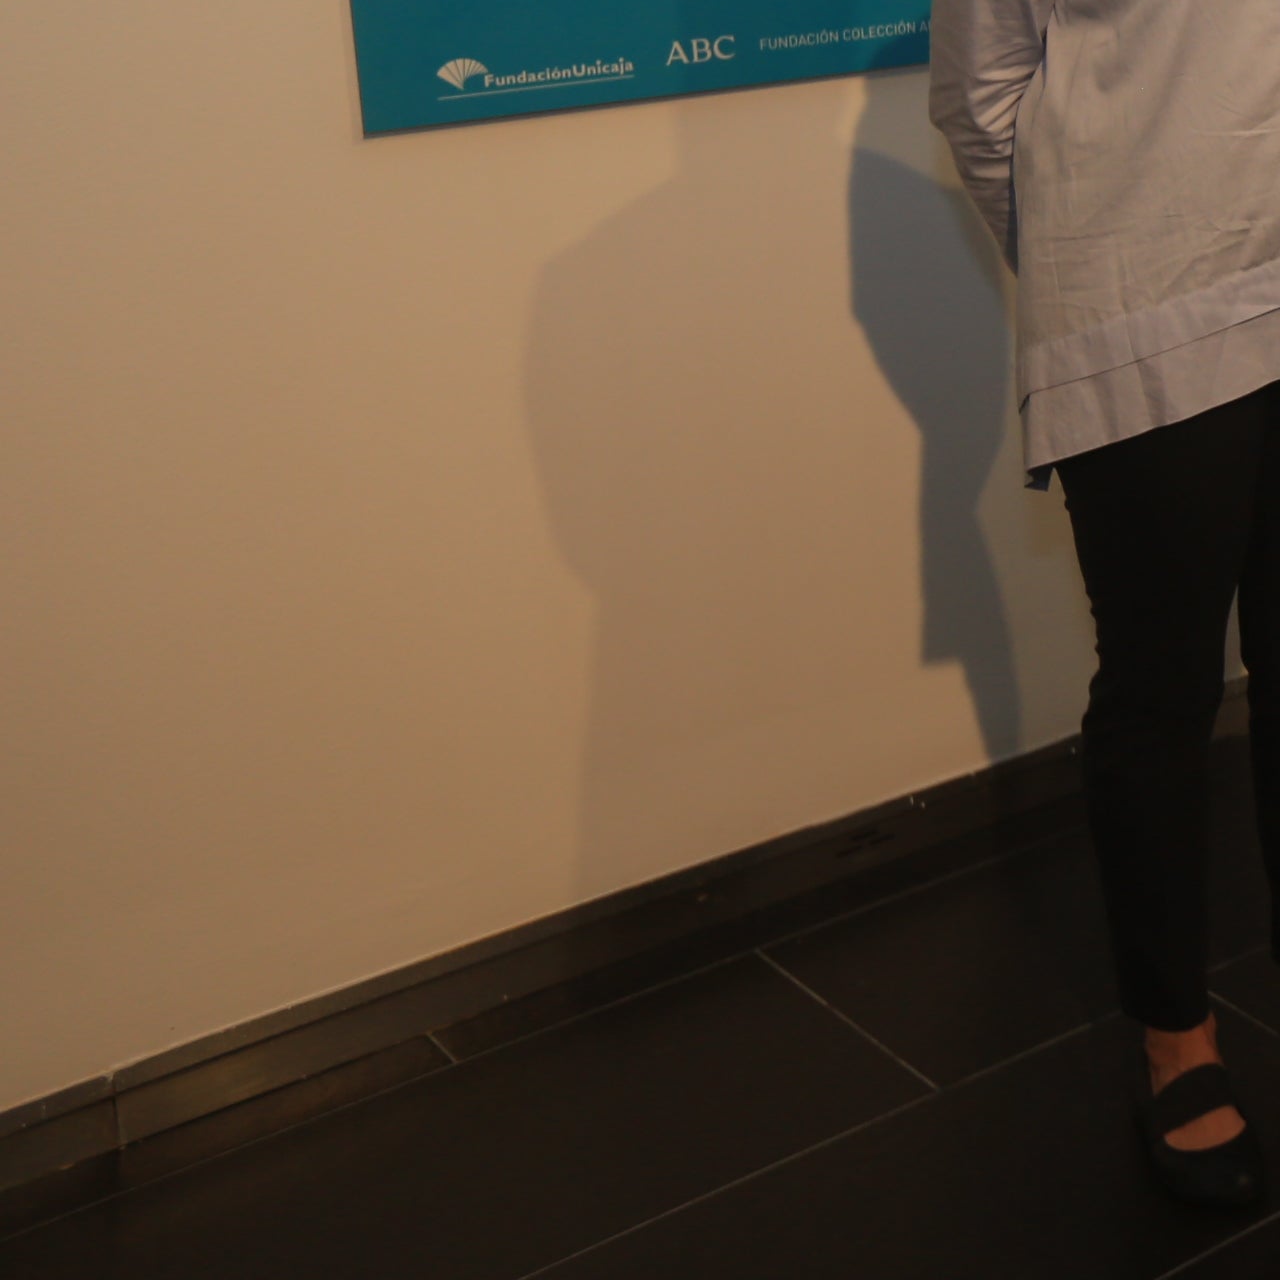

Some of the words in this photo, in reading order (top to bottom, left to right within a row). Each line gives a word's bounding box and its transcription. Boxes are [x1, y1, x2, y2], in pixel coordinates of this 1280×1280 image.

[665, 34, 736, 67] ABC
[759, 29, 840, 51] FUNDACIÓN
[842, 19, 916, 41] COLECCIÓN
